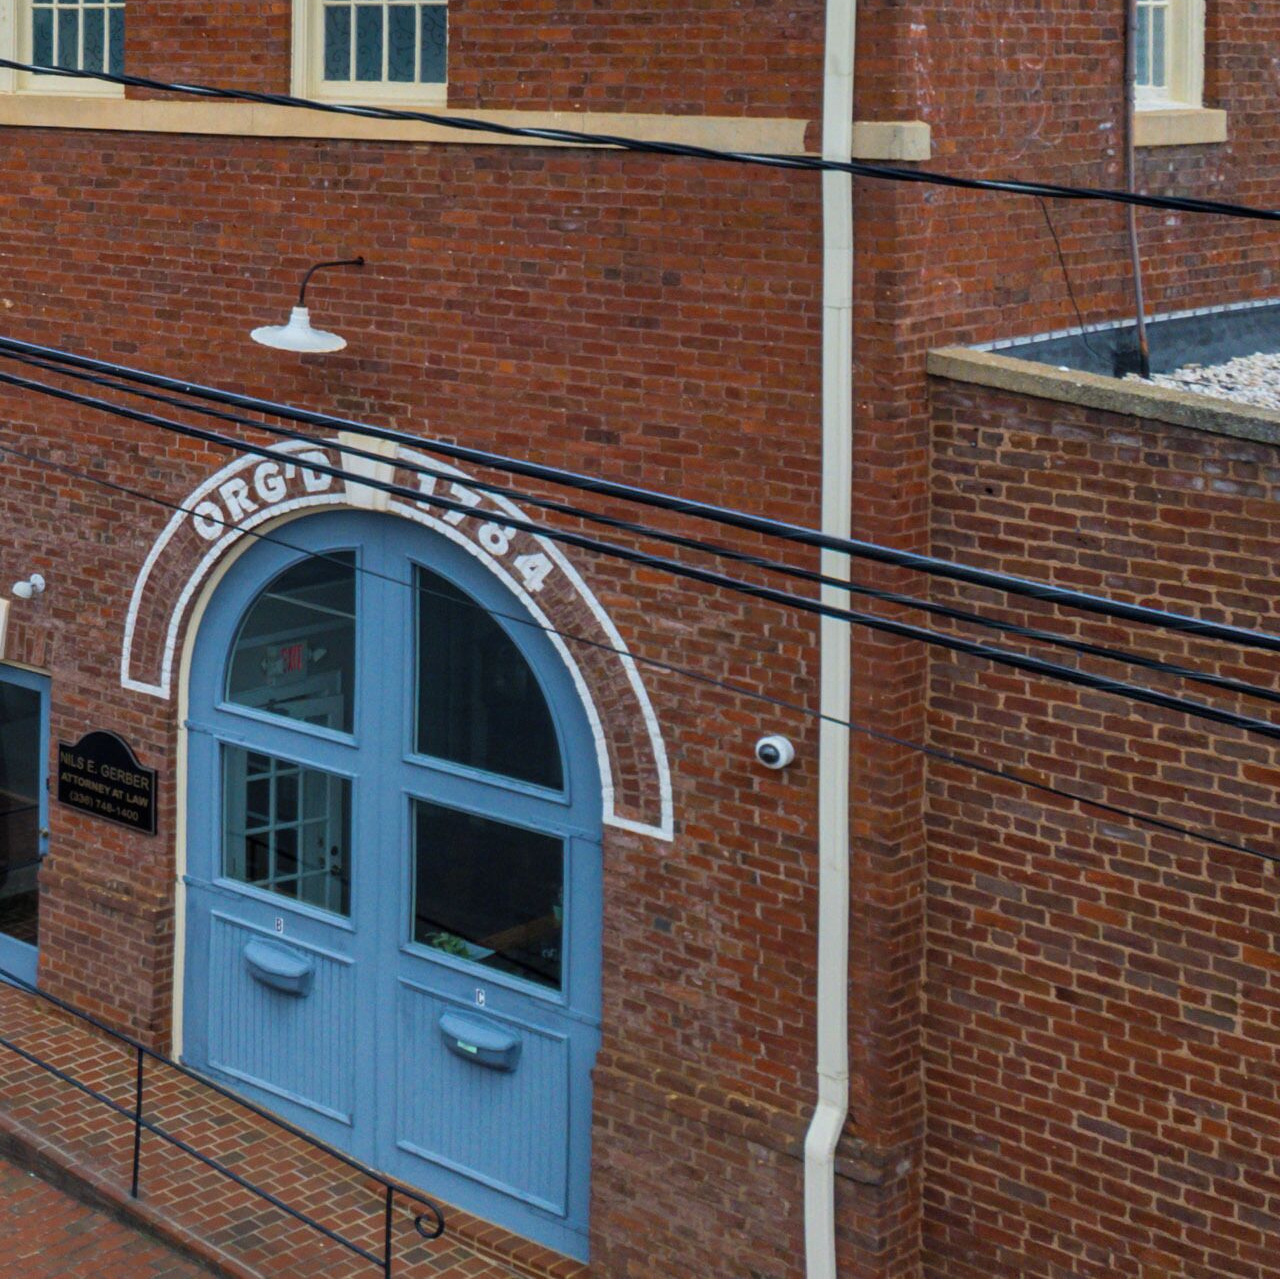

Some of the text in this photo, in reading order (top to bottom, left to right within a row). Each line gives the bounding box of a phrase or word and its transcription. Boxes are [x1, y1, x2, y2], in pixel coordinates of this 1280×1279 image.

[192, 450, 554, 593] ORG'D 1784
[60, 750, 150, 792] NILS E. GERBER
[60, 772, 149, 808] ATTORNEY AT LAW
